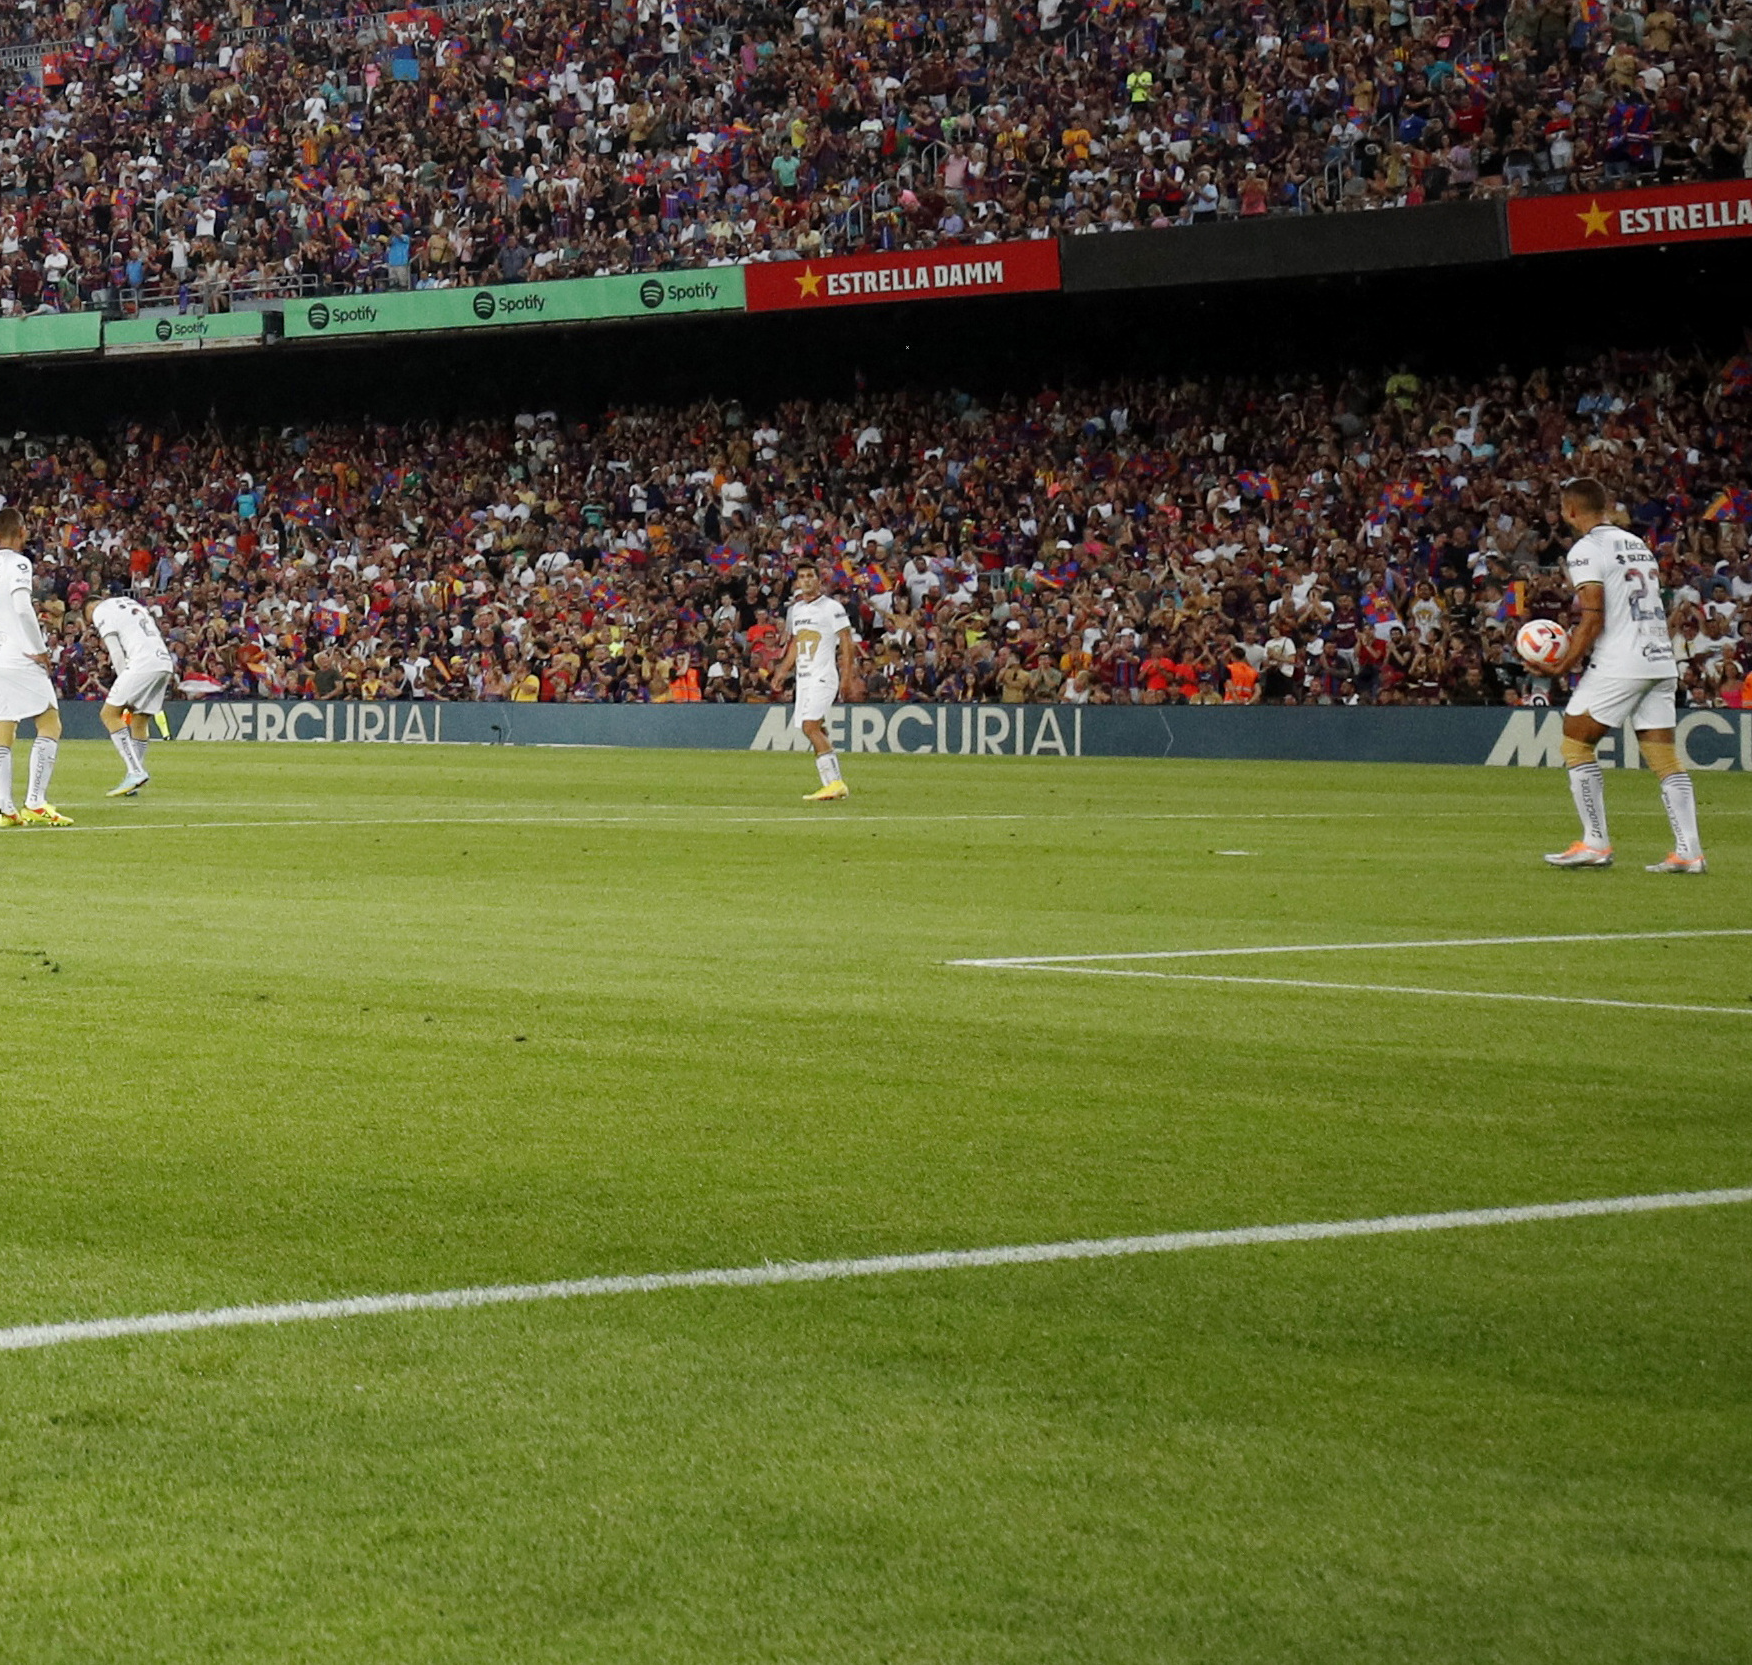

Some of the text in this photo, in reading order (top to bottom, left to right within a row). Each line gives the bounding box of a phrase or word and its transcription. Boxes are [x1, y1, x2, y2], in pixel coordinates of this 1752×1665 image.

[1619, 199, 1752, 234] ESTRELLA
[827, 261, 1004, 296] ESTRELLA DAMM
[668, 284, 718, 301] Spotify
[499, 294, 546, 313] Spotify
[332, 307, 377, 324] Spotify
[175, 321, 209, 336] Spotify
[1627, 553, 1656, 564] SUZUK
